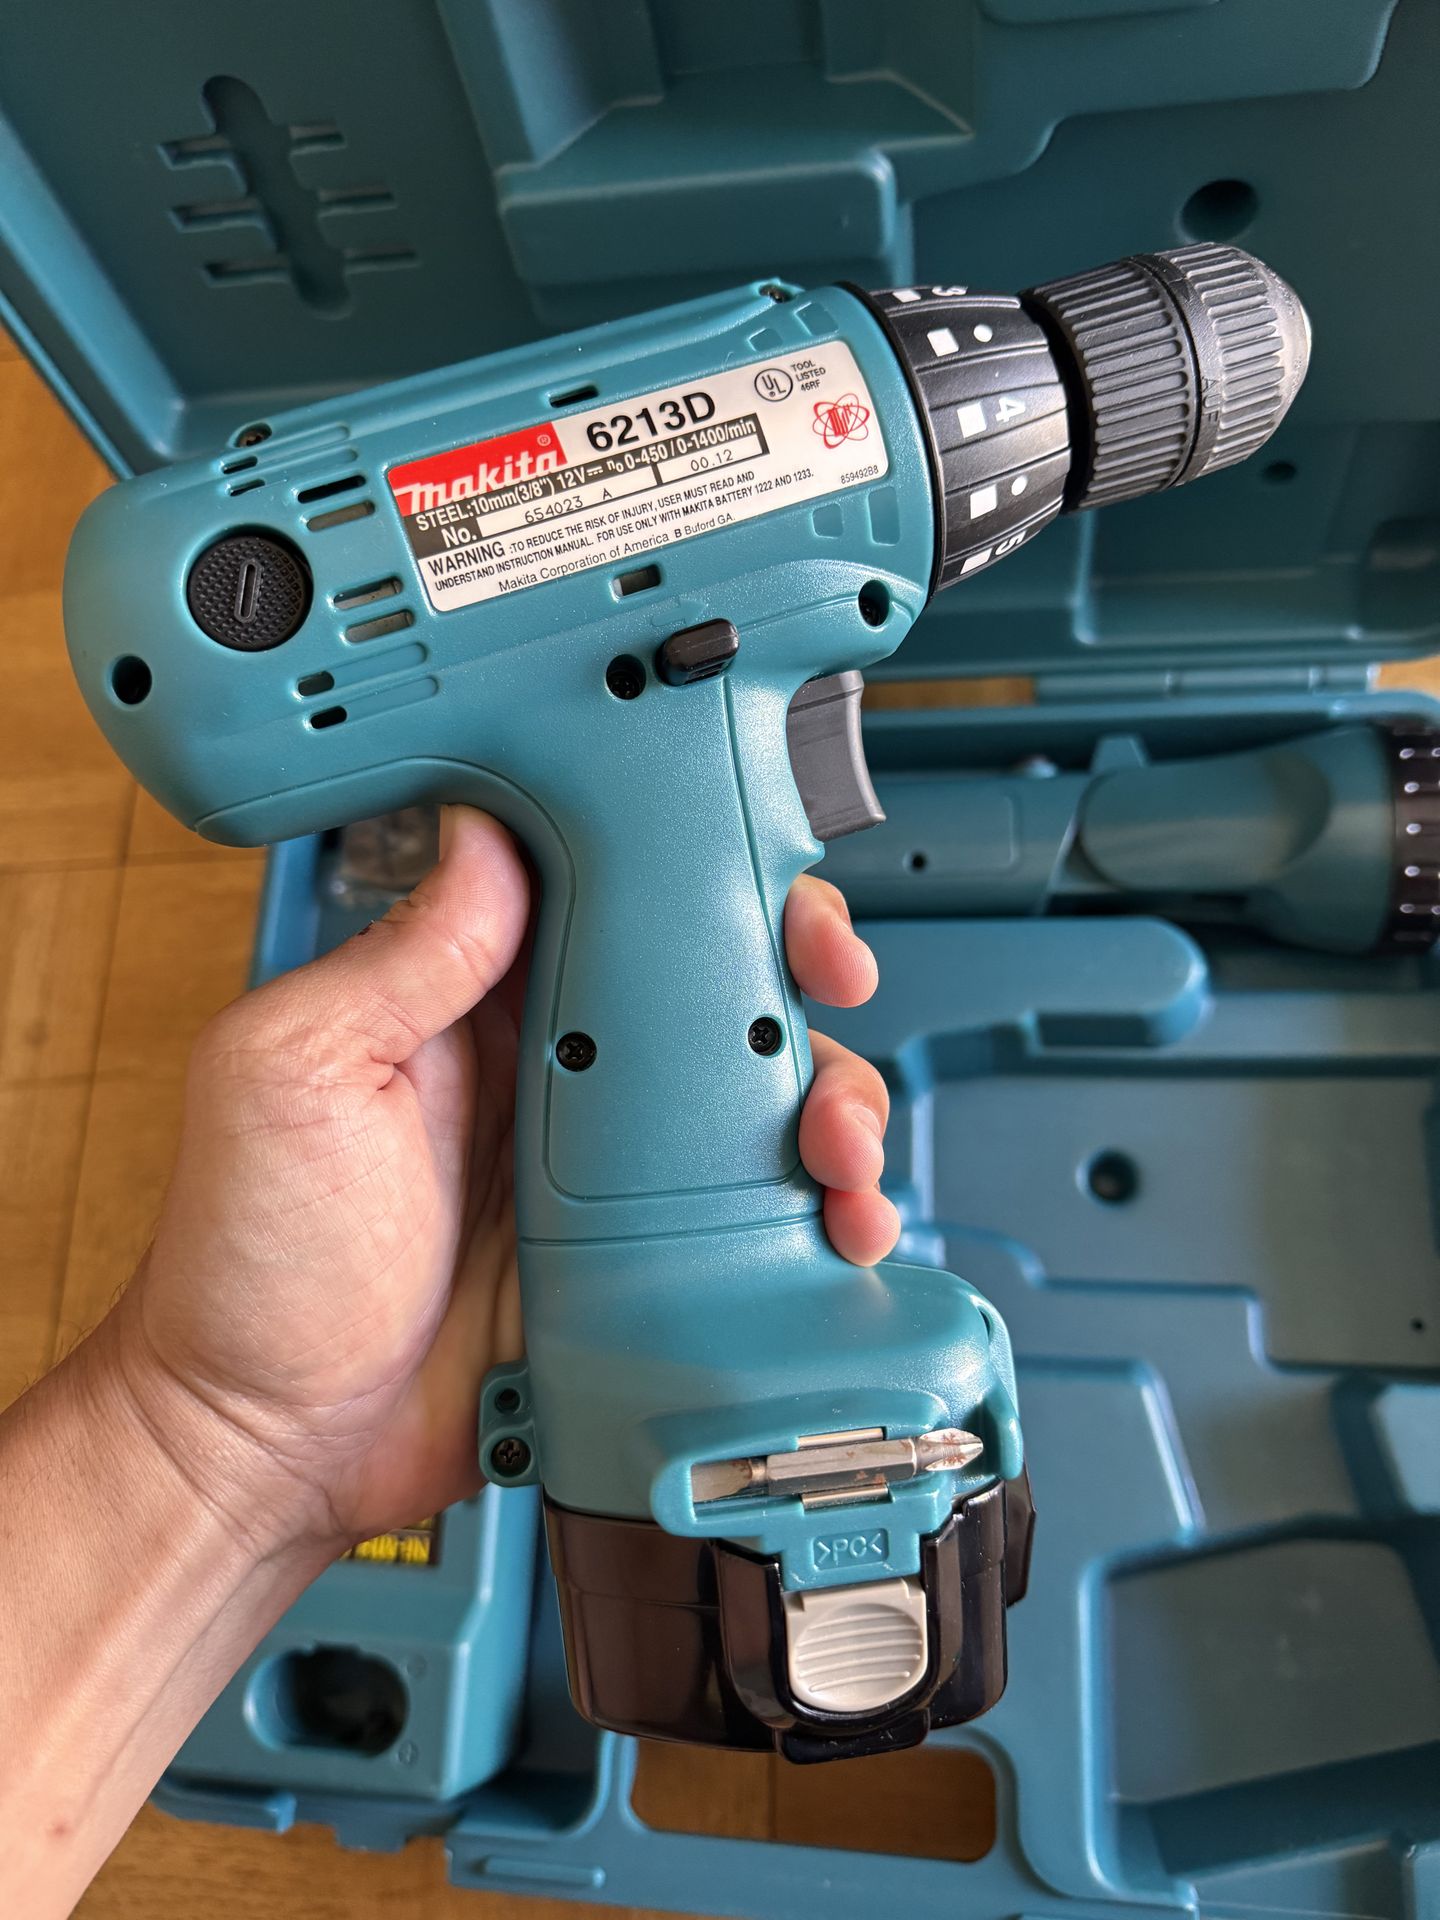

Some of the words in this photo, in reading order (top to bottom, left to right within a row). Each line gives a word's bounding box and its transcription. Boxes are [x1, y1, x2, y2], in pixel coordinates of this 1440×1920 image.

[761, 374, 787, 393] UL
[791, 360, 816, 372] TOOL
[795, 367, 826, 382] LISTED
[801, 379, 821, 391] 46RF
[587, 391, 715, 452] 6213D
[995, 398, 1026, 424] 4
[393, 450, 567, 515] makita
[428, 541, 506, 577] WARNING
[527, 528, 564, 548] REDUCE
[565, 522, 584, 536] THE
[585, 515, 607, 532] RISK
[608, 511, 621, 524] OF
[621, 501, 657, 520] INJURY,
[657, 493, 683, 508] USER
[683, 484, 708, 500] MUST
[709, 477, 735, 493] READ
[736, 470, 755, 484] AND
[435, 564, 495, 591] UNDERSTAND
[495, 547, 554, 574] INSTRUCTION
[554, 536, 594, 556] MANUAL.
[596, 528, 615, 542] FOR
[616, 523, 634, 536] USE
[634, 515, 659, 531] ONLY
[658, 508, 681, 524] WITH
[681, 499, 715, 516] MAKITA
[715, 486, 753, 506] BATTERY
[754, 480, 773, 494] 1222
[774, 474, 792, 488] AND
[793, 468, 814, 482] 1233.
[441, 526, 478, 549] No.
[524, 495, 583, 524] 654023
[602, 487, 613, 501] A
[498, 573, 538, 592] Makita
[539, 552, 606, 580] Corporation
[609, 545, 621, 558] of
[623, 534, 670, 554] America
[684, 518, 716, 535] Buford
[717, 513, 736, 525] GA.
[996, 529, 1026, 556] 5
